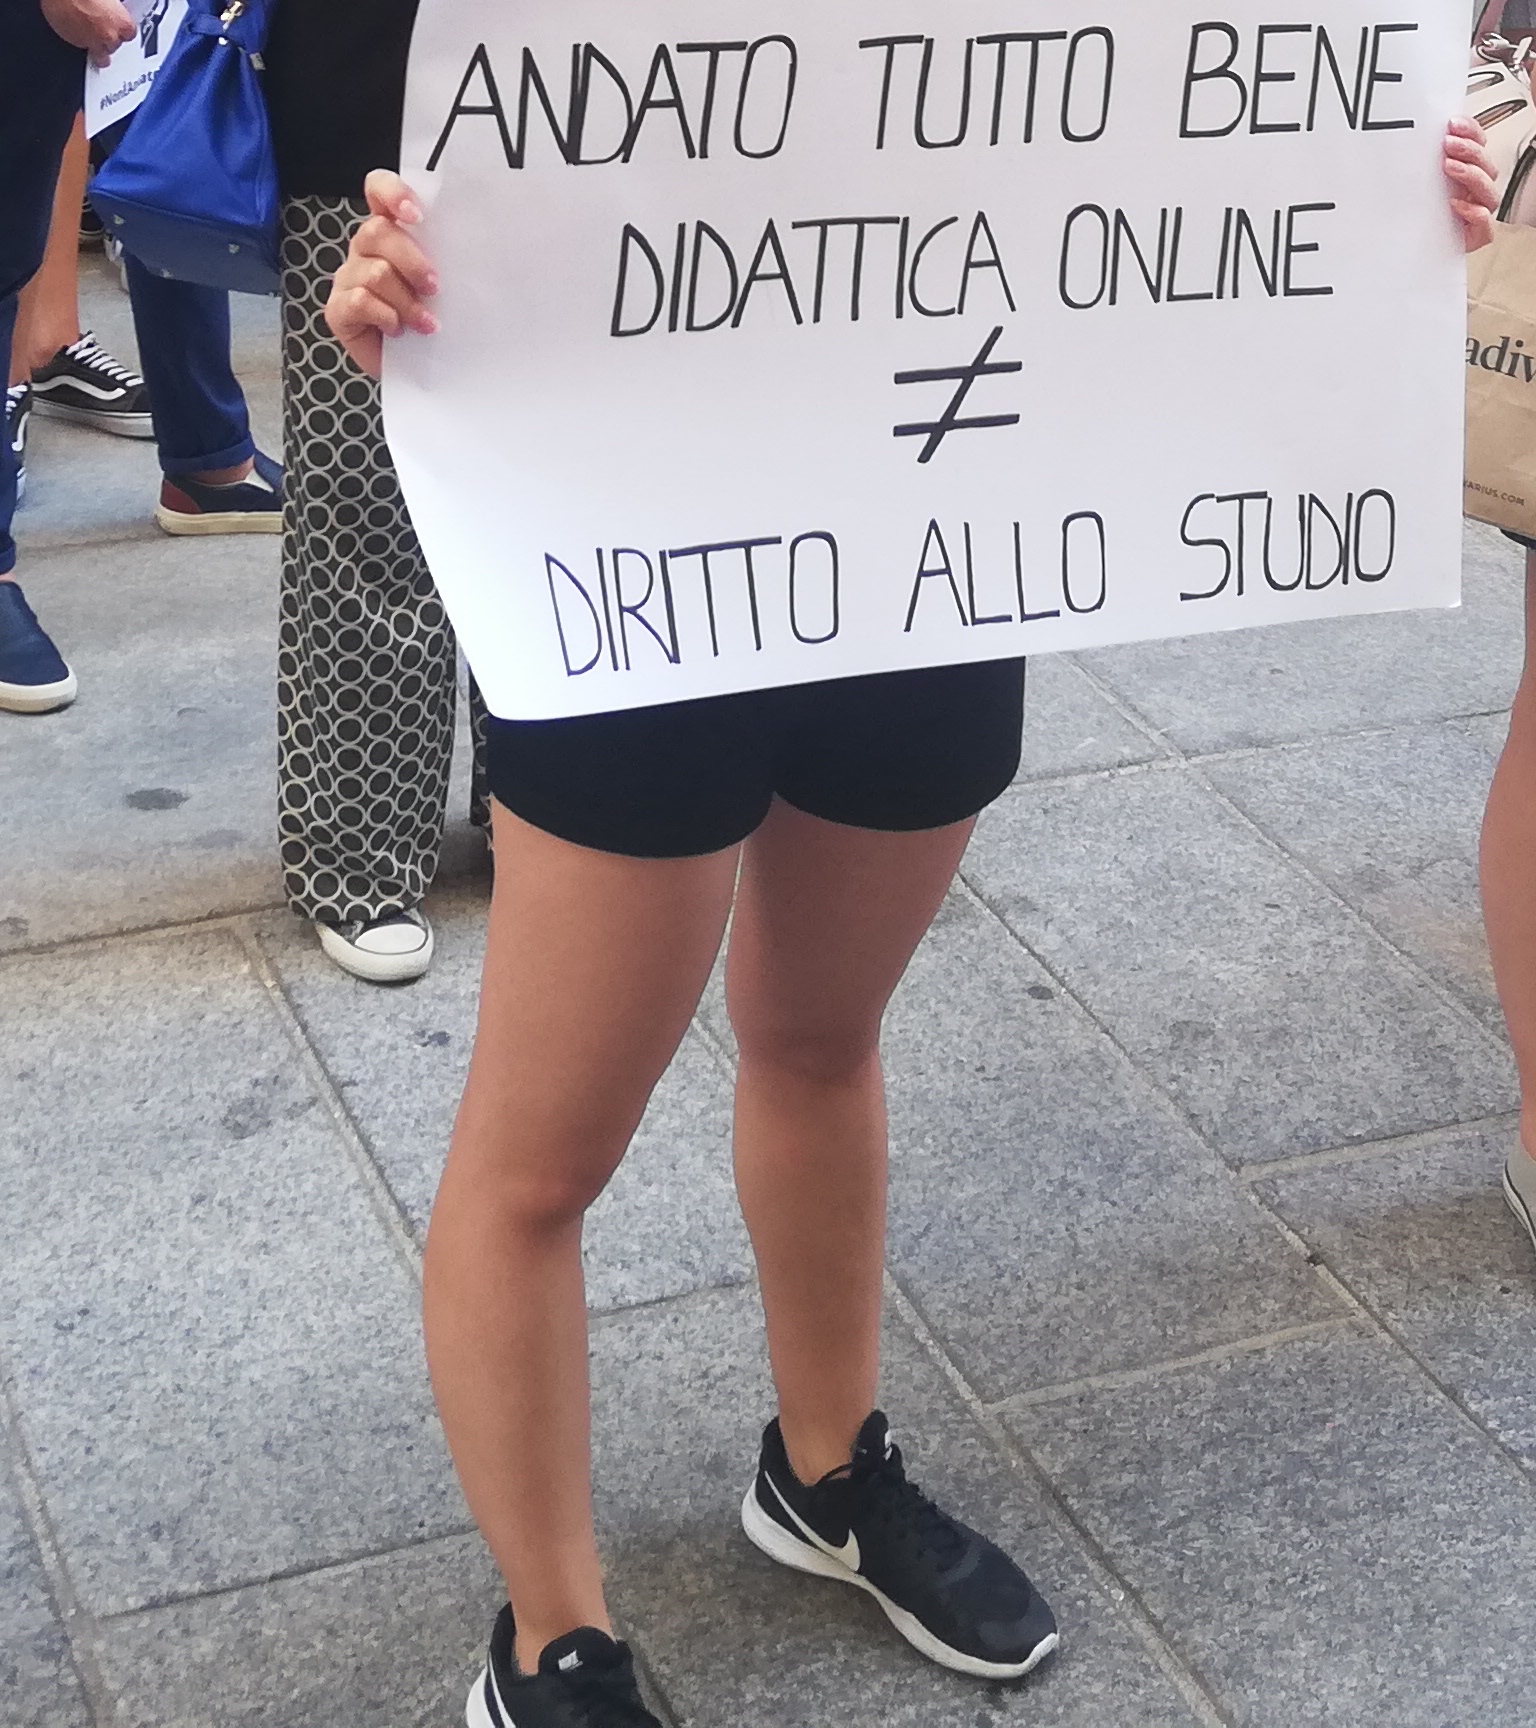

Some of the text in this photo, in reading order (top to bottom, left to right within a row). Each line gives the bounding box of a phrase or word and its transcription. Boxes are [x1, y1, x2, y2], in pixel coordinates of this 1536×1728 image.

[425, 21, 1420, 171] ANDATO TUTTO BENE
[610, 201, 1337, 338] DIDATTICA ONLINE
[544, 487, 1398, 678] DIRITTO ALLO STUDIO
